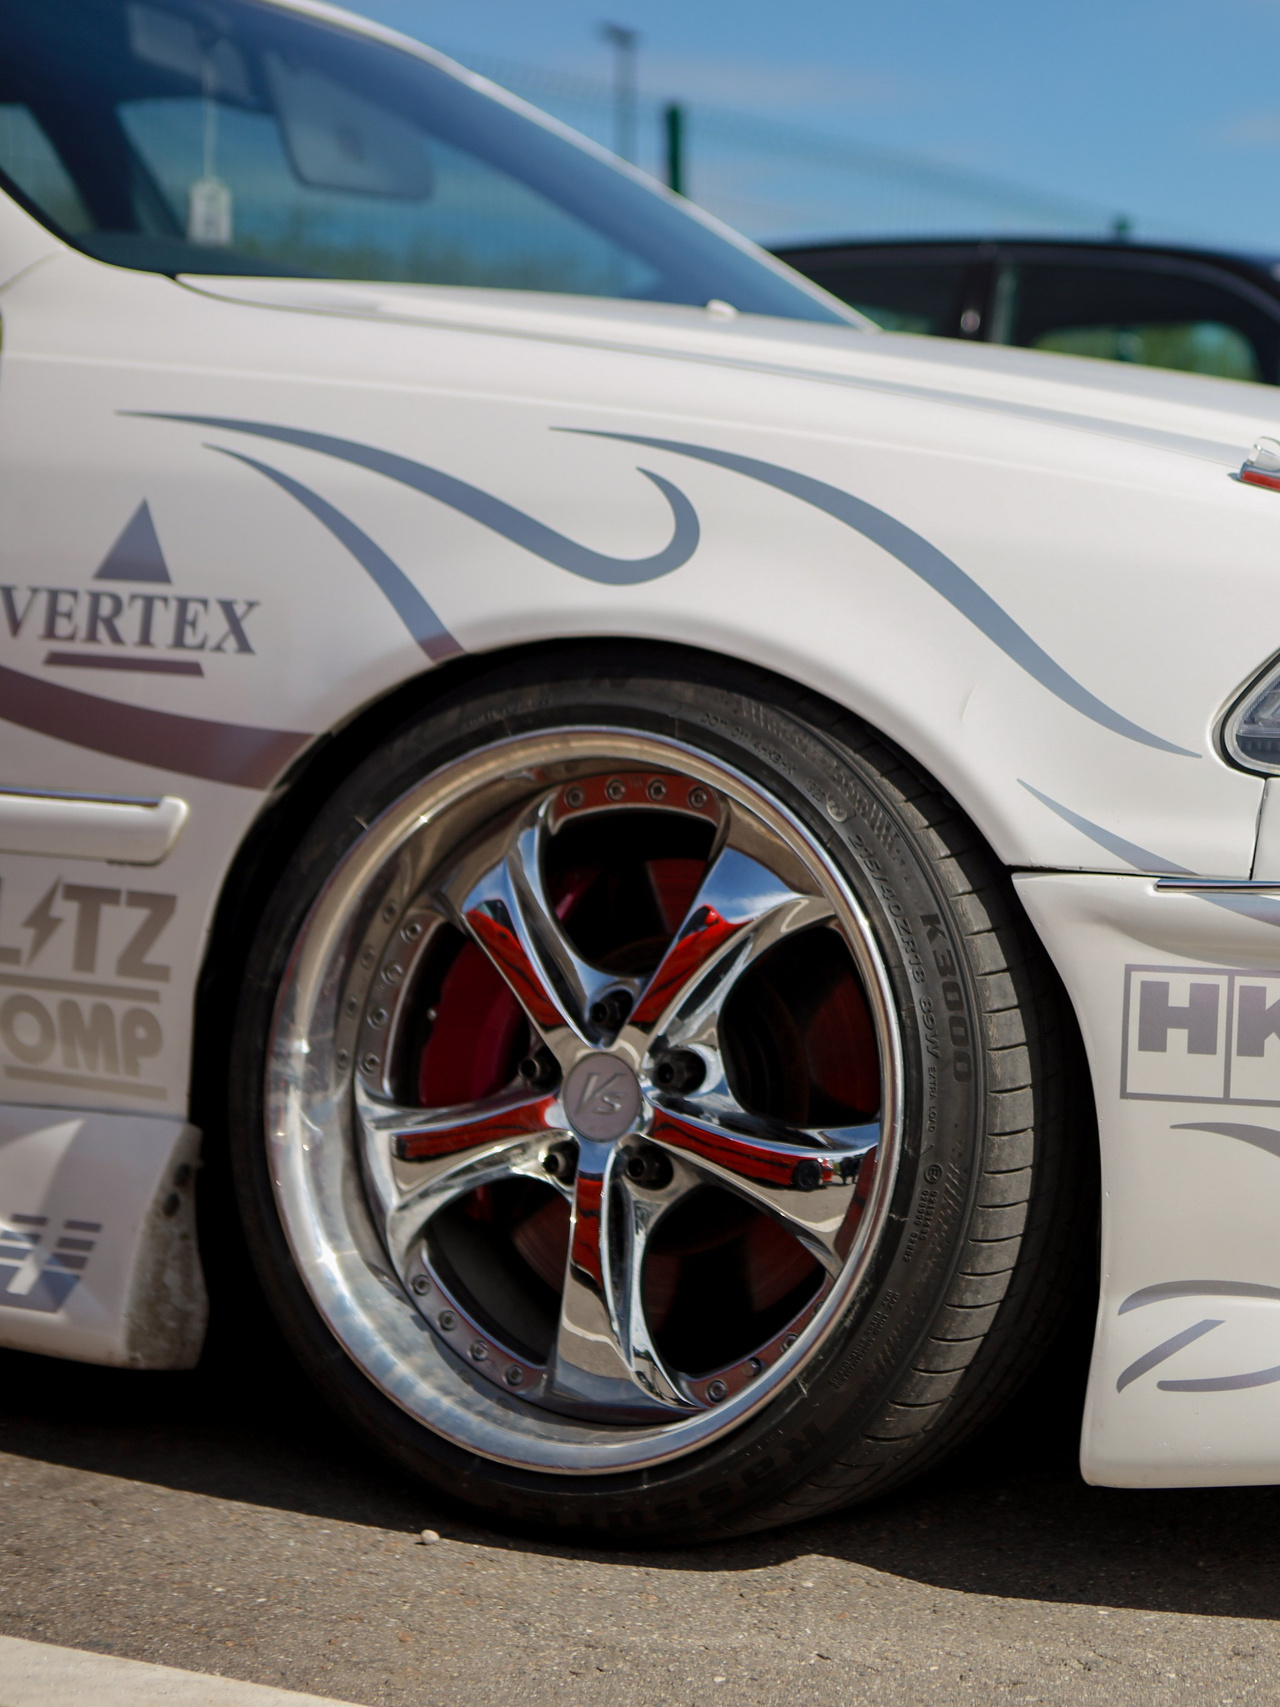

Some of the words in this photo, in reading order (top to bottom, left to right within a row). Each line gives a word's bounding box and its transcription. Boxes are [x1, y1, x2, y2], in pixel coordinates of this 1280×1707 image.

[0, 585, 261, 655] VERTEX
[848, 832, 926, 984] 215/40ZR18
[919, 913, 972, 1083] K3000
[919, 995, 941, 1060] 89W
[927, 1066, 938, 1101] EXTRA
[927, 1105, 938, 1133] LOAD
